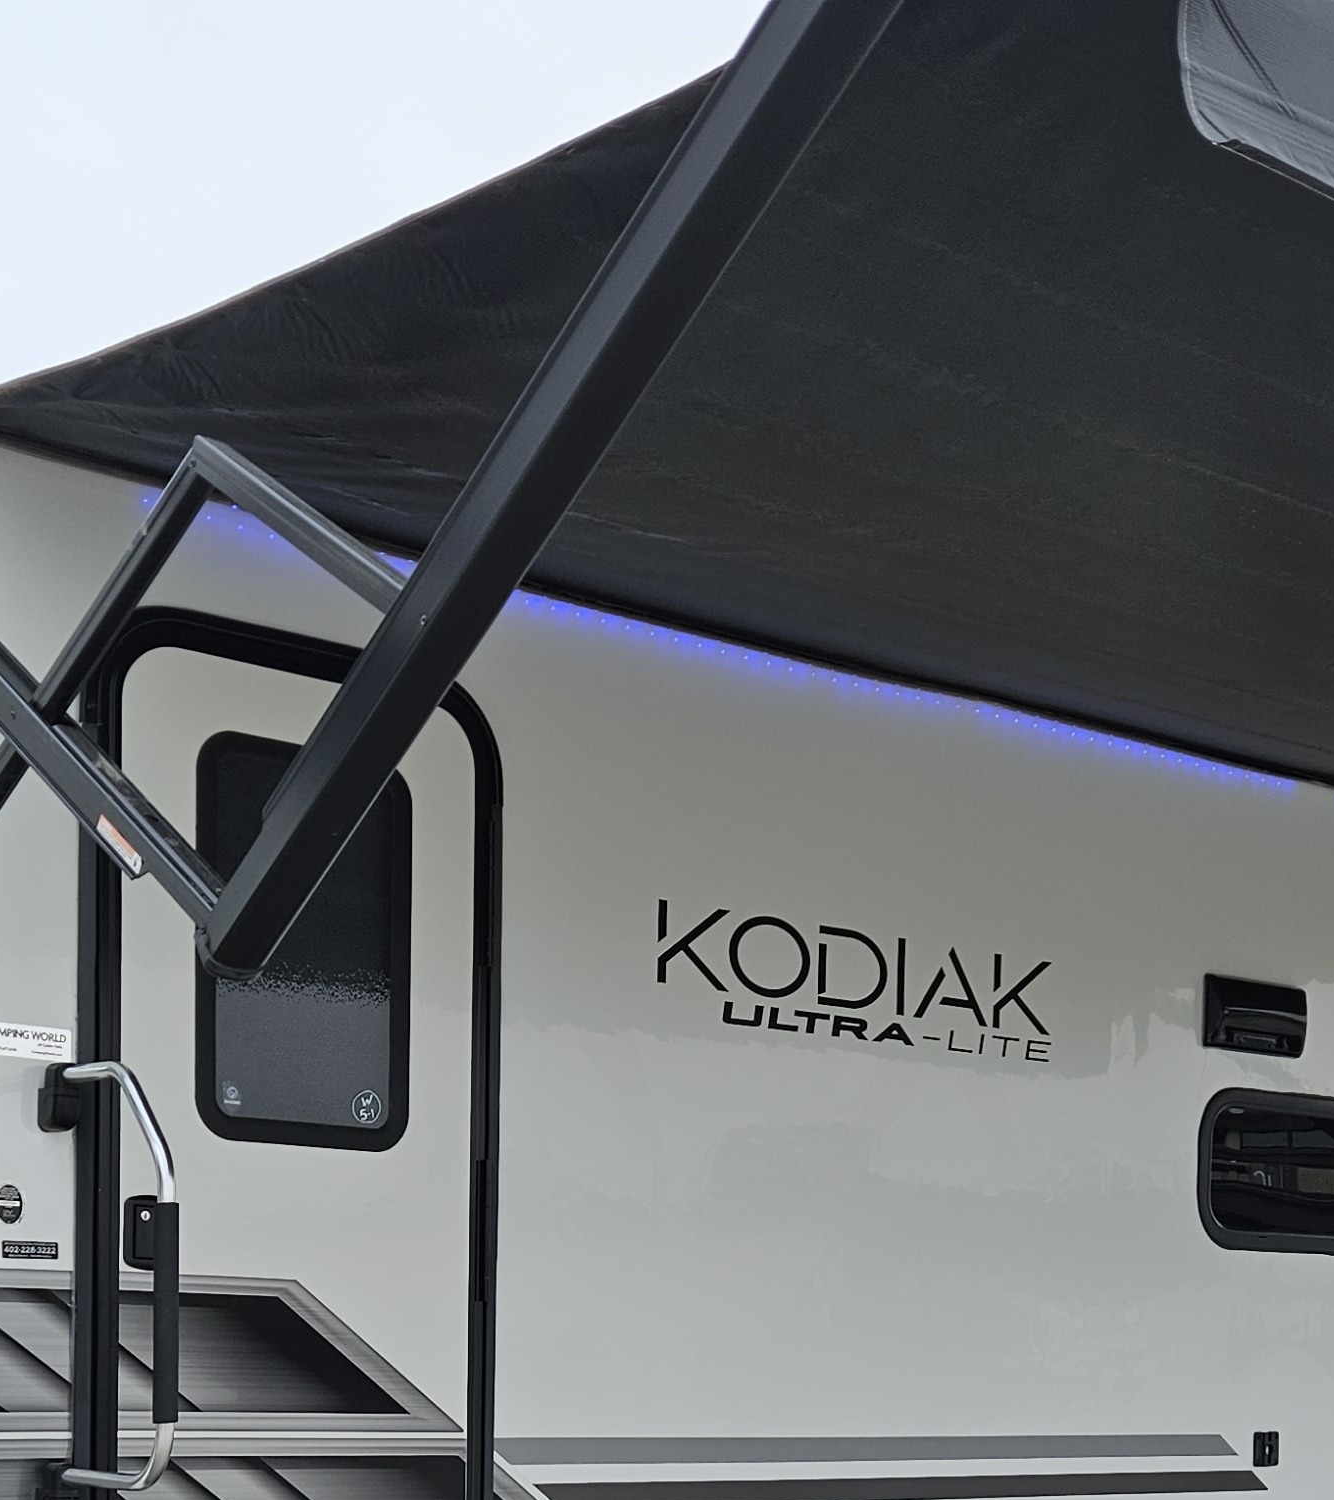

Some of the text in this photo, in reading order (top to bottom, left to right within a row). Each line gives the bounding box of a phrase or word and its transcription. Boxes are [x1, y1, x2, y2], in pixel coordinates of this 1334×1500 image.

[657, 899, 1052, 1036] KODIAK
[31, 1031, 66, 1043] WORLD
[722, 1001, 1052, 1062] ULTRA-LITE
